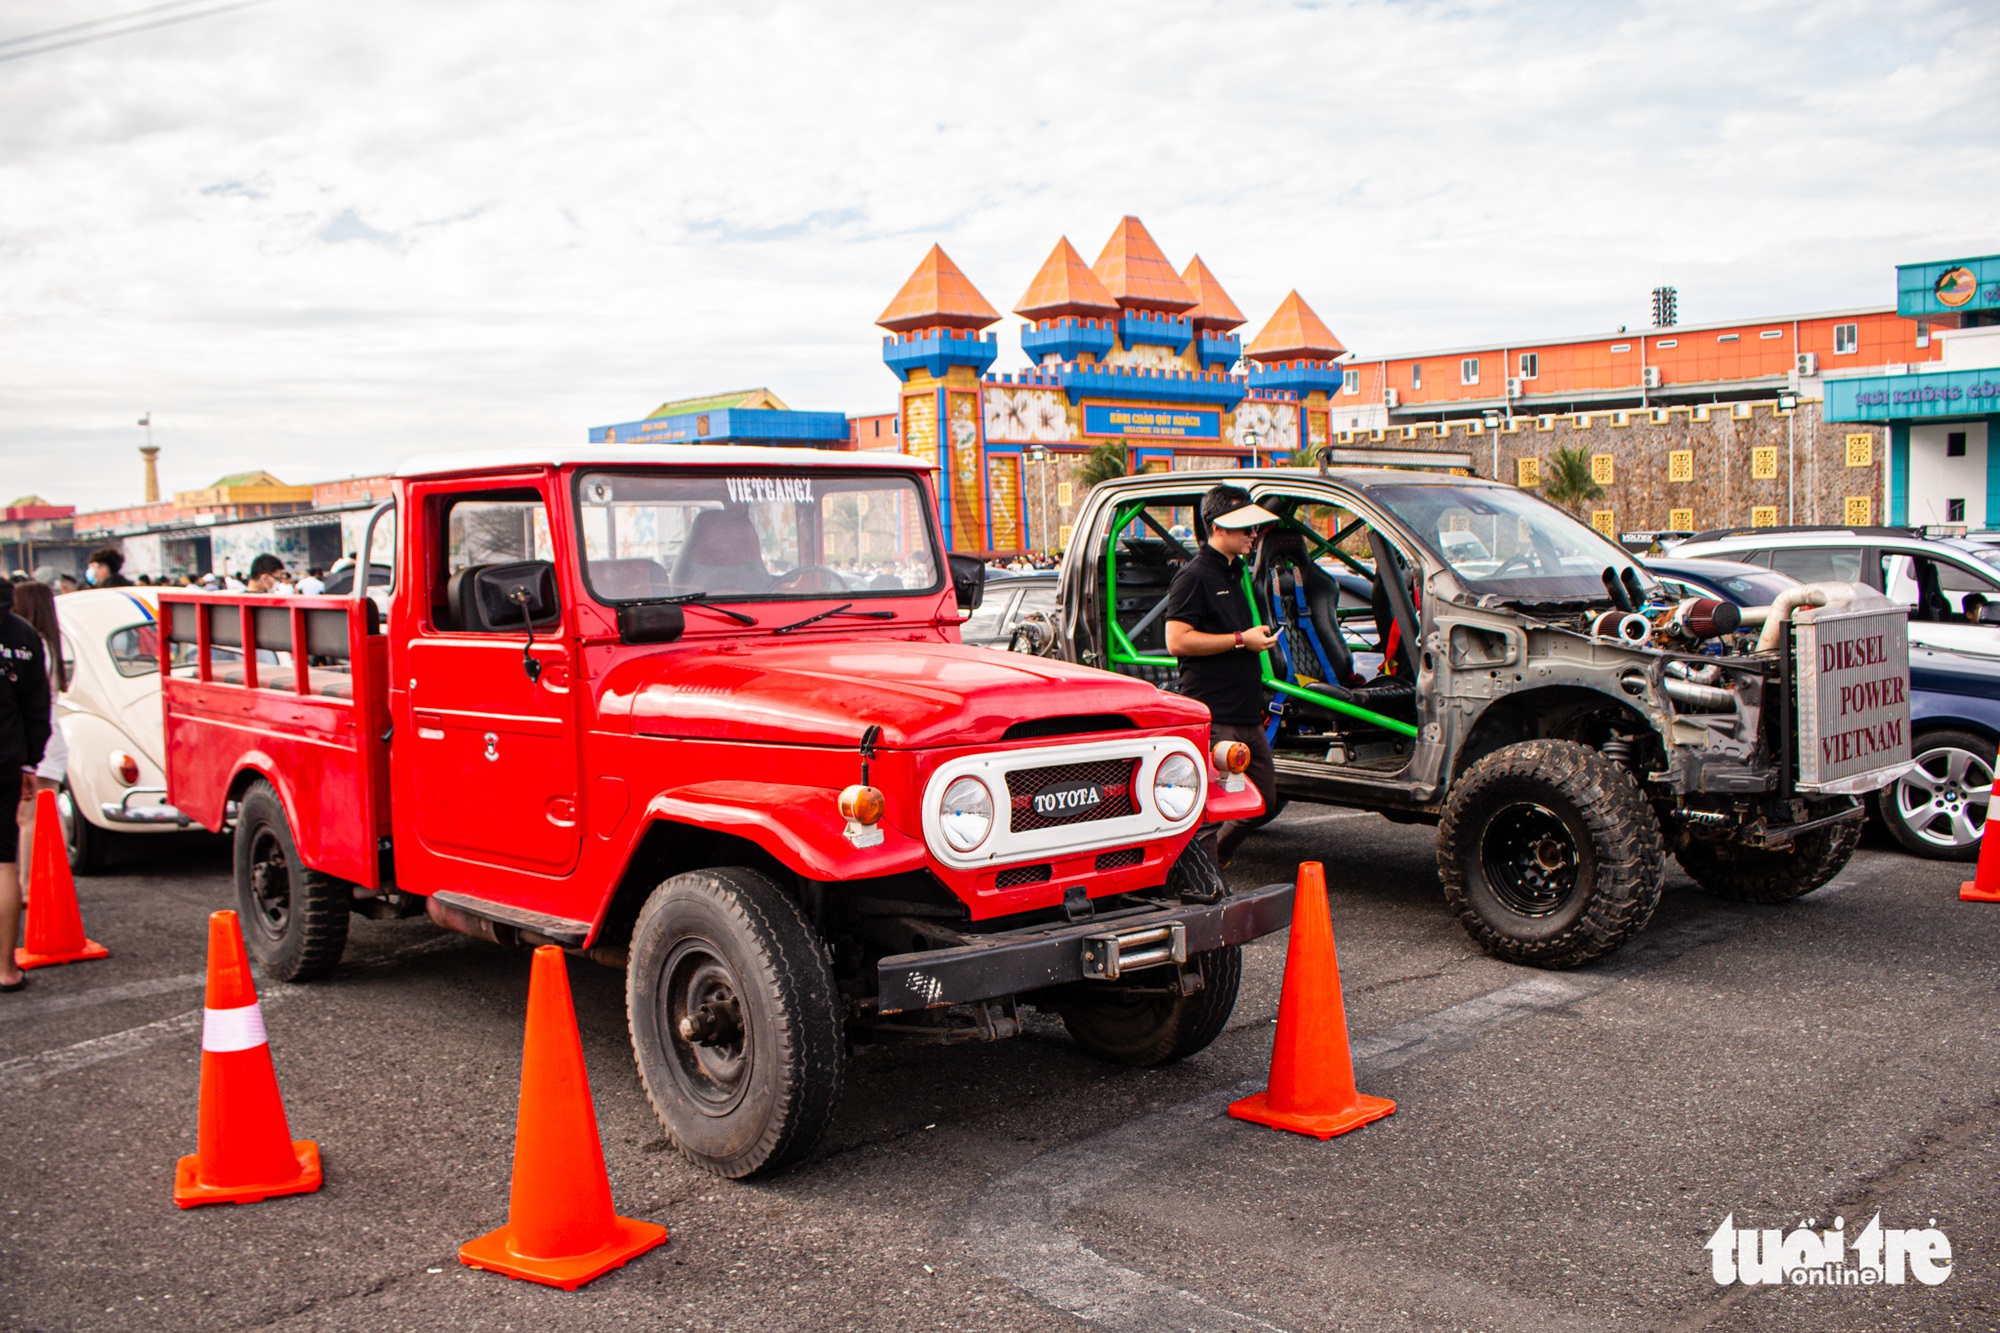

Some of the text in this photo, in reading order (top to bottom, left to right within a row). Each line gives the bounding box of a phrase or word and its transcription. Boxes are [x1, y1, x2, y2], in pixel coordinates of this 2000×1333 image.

[1856, 390, 1890, 407] NƠI
[1893, 385, 1962, 405] KHÔNG
[1110, 409, 1131, 424] KÍNH
[1131, 411, 1155, 426] CHÀO
[1173, 413, 1200, 427] KHÁCH
[725, 477, 814, 503] VIETGANGZ
[1820, 635, 1888, 674] DIESEL
[1840, 676, 1905, 717] POWER
[1820, 718, 1903, 766] VIETNAM
[1034, 786, 1100, 813] TOYOTA
